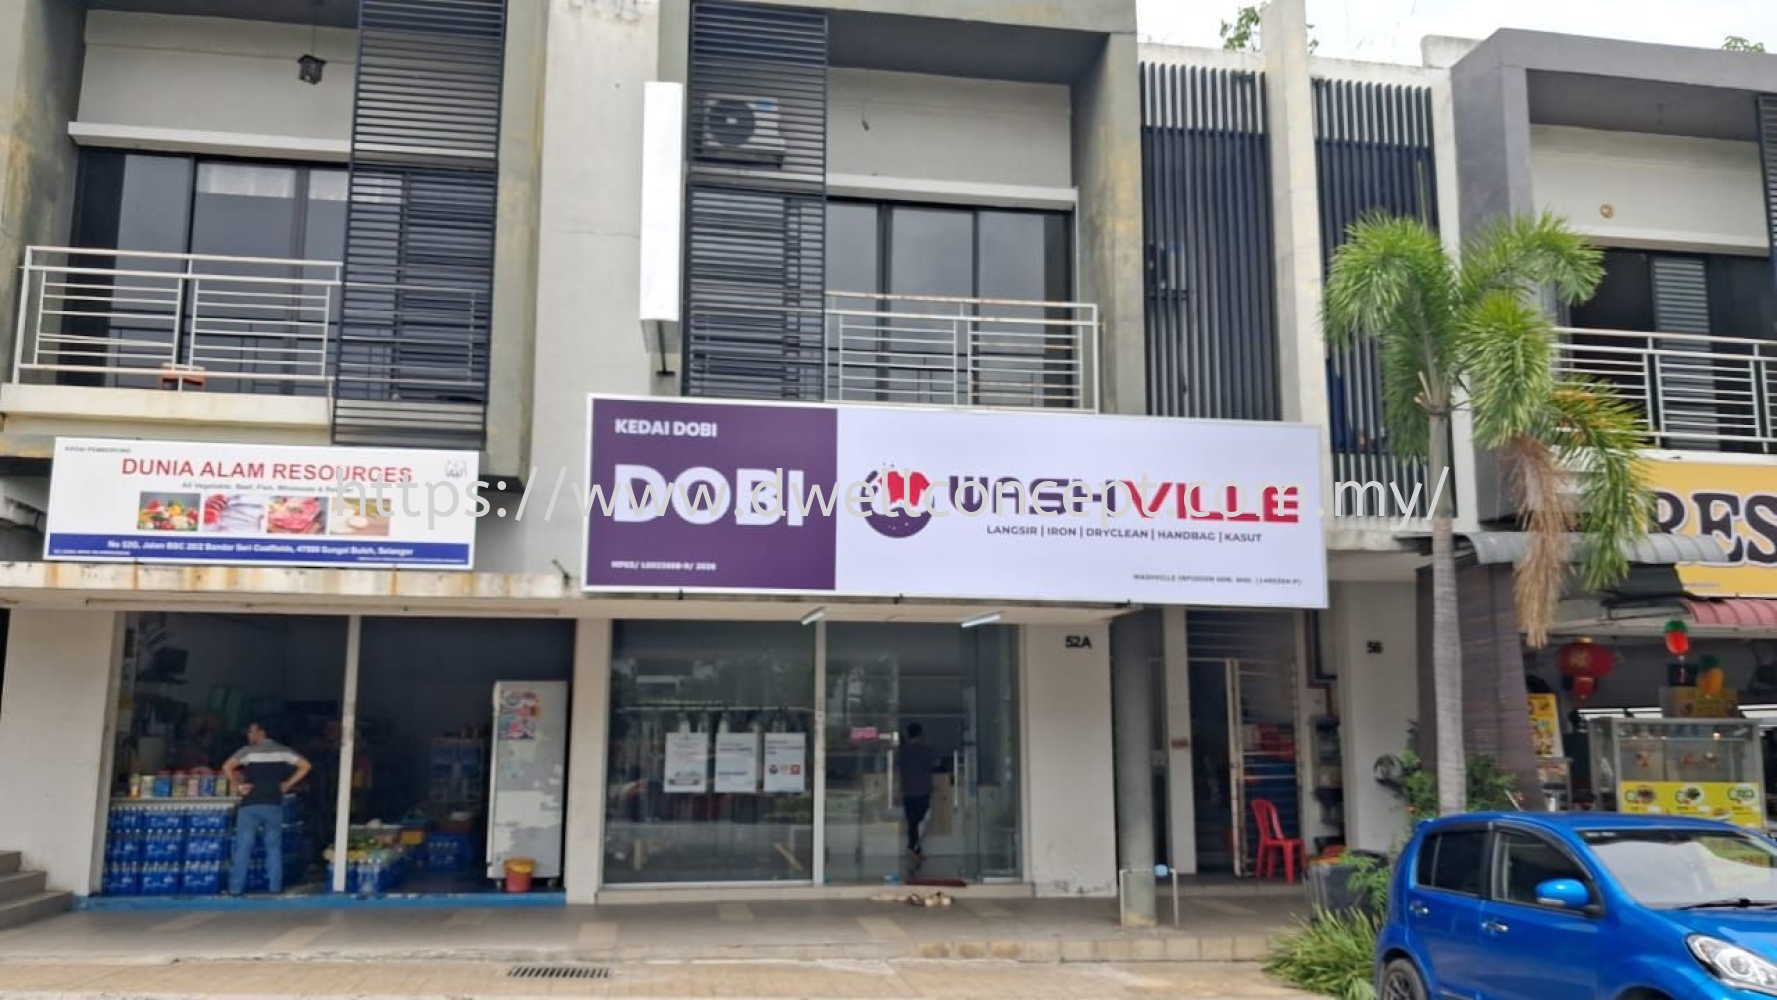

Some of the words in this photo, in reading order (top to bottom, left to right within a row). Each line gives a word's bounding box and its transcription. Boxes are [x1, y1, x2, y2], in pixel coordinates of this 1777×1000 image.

[614, 418, 670, 436] KEDAI
[672, 421, 717, 438] DOBI
[122, 458, 194, 476] DUNIA
[200, 460, 265, 478] ALAM
[272, 463, 412, 483] RESOURCES
[613, 463, 805, 527] DOBI
[948, 474, 1300, 524] WASHVILLE
[986, 525, 1038, 536] LANGSIR
[1047, 527, 1077, 537] IRON
[1086, 528, 1148, 539] DRYCLEAN
[1157, 531, 1216, 541] HANDBAG
[1224, 532, 1263, 543] KASUT
[1065, 635, 1092, 648] 52A
